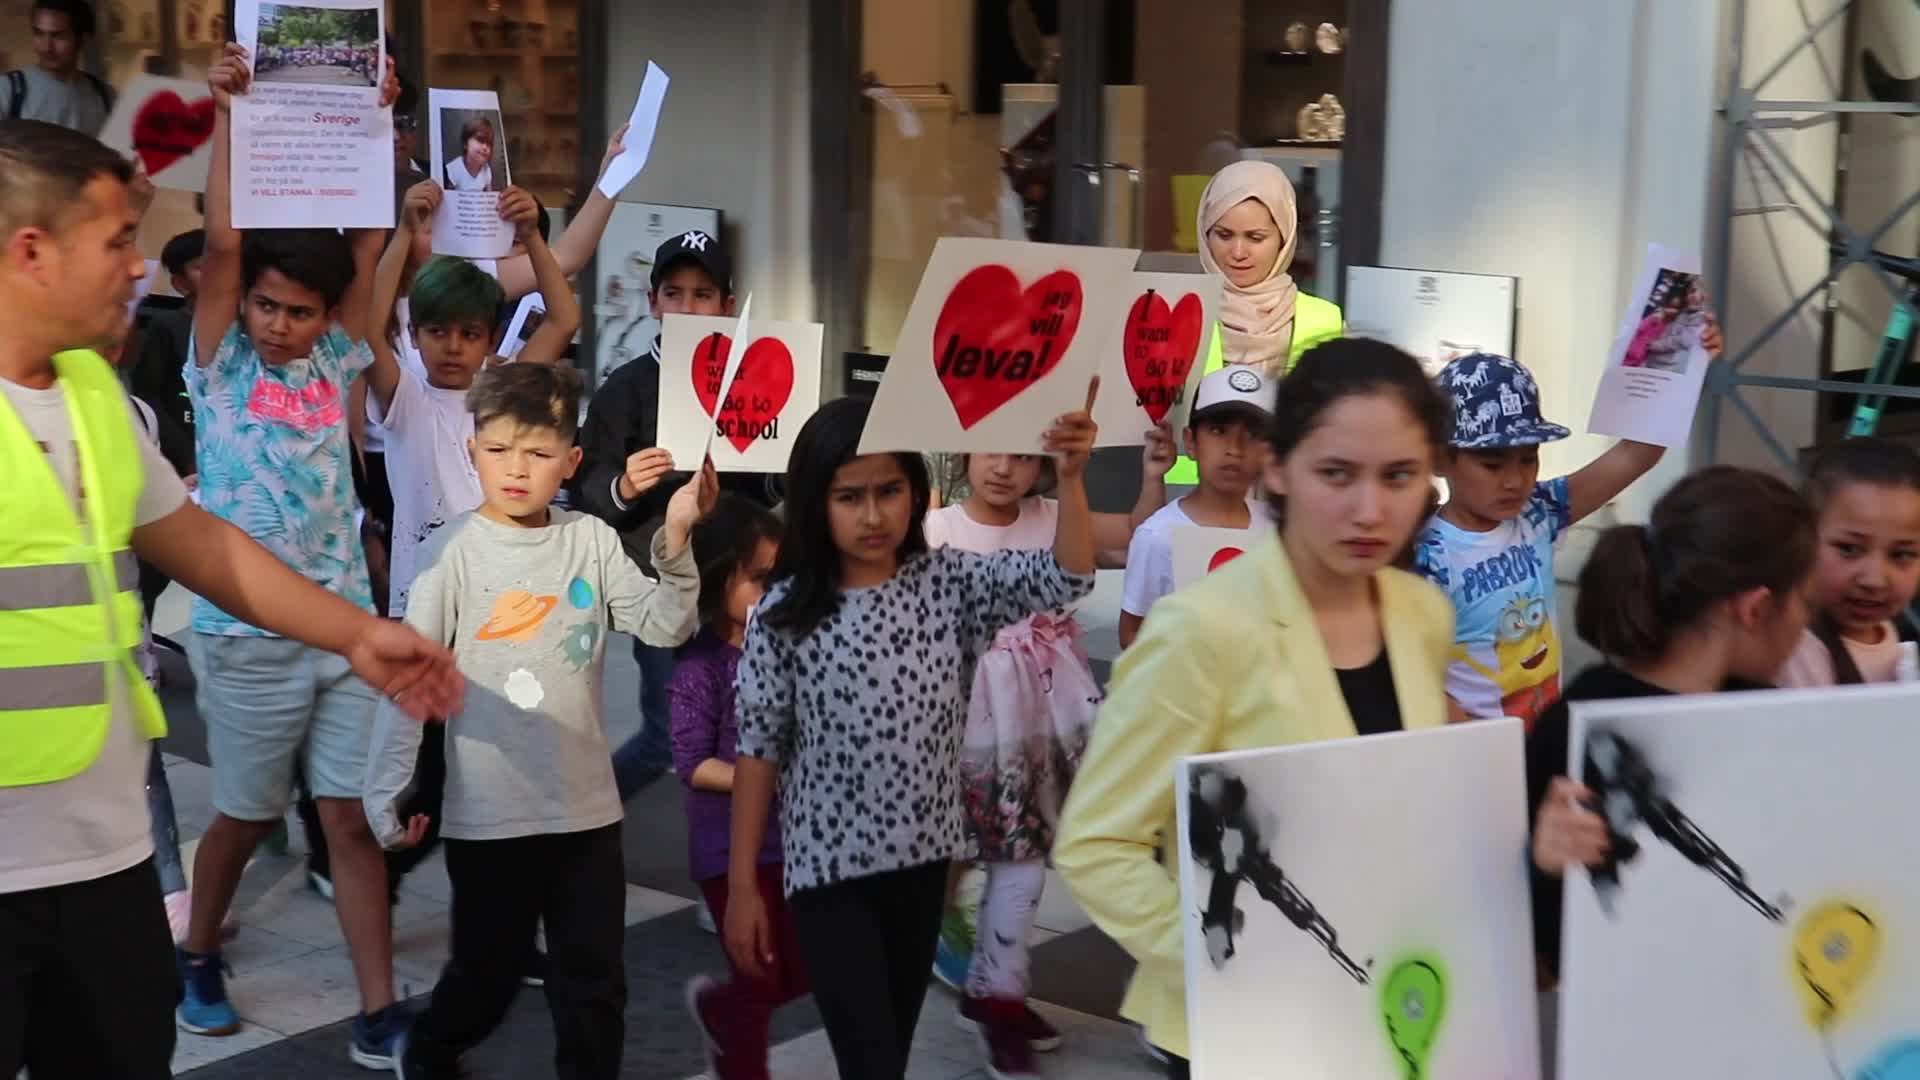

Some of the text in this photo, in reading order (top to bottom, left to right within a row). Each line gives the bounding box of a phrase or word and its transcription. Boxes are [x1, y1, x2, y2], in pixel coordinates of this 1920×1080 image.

[312, 112, 360, 126] Sverige
[681, 231, 708, 252] NY
[1041, 291, 1073, 310] jag
[1030, 313, 1065, 336] vill
[937, 333, 1053, 381] leva!
[752, 393, 772, 413] to
[716, 414, 779, 441] school
